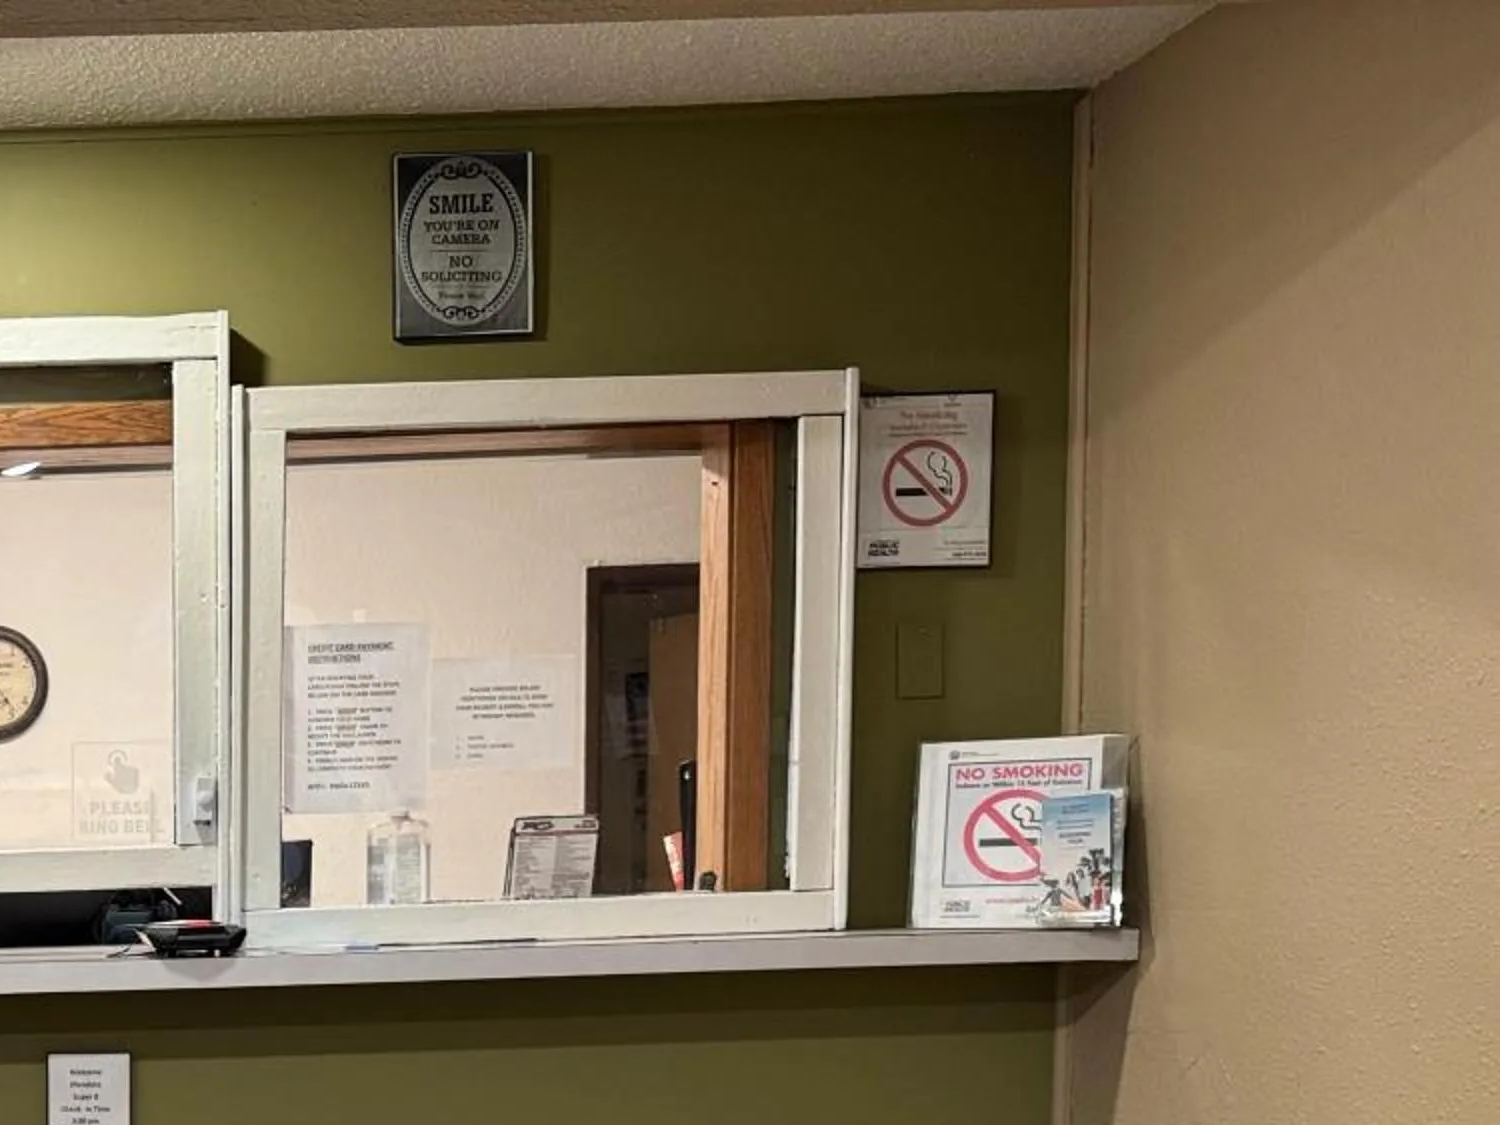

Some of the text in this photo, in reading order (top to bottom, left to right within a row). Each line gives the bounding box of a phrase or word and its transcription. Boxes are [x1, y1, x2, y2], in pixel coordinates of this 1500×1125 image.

[429, 193, 494, 215] SMILE
[424, 219, 500, 232] YOU'RE ON
[432, 234, 491, 245] CAMERA
[449, 256, 473, 268] NO
[422, 271, 501, 282] SOLICITING
[956, 763, 1083, 781] NO SMOKING
